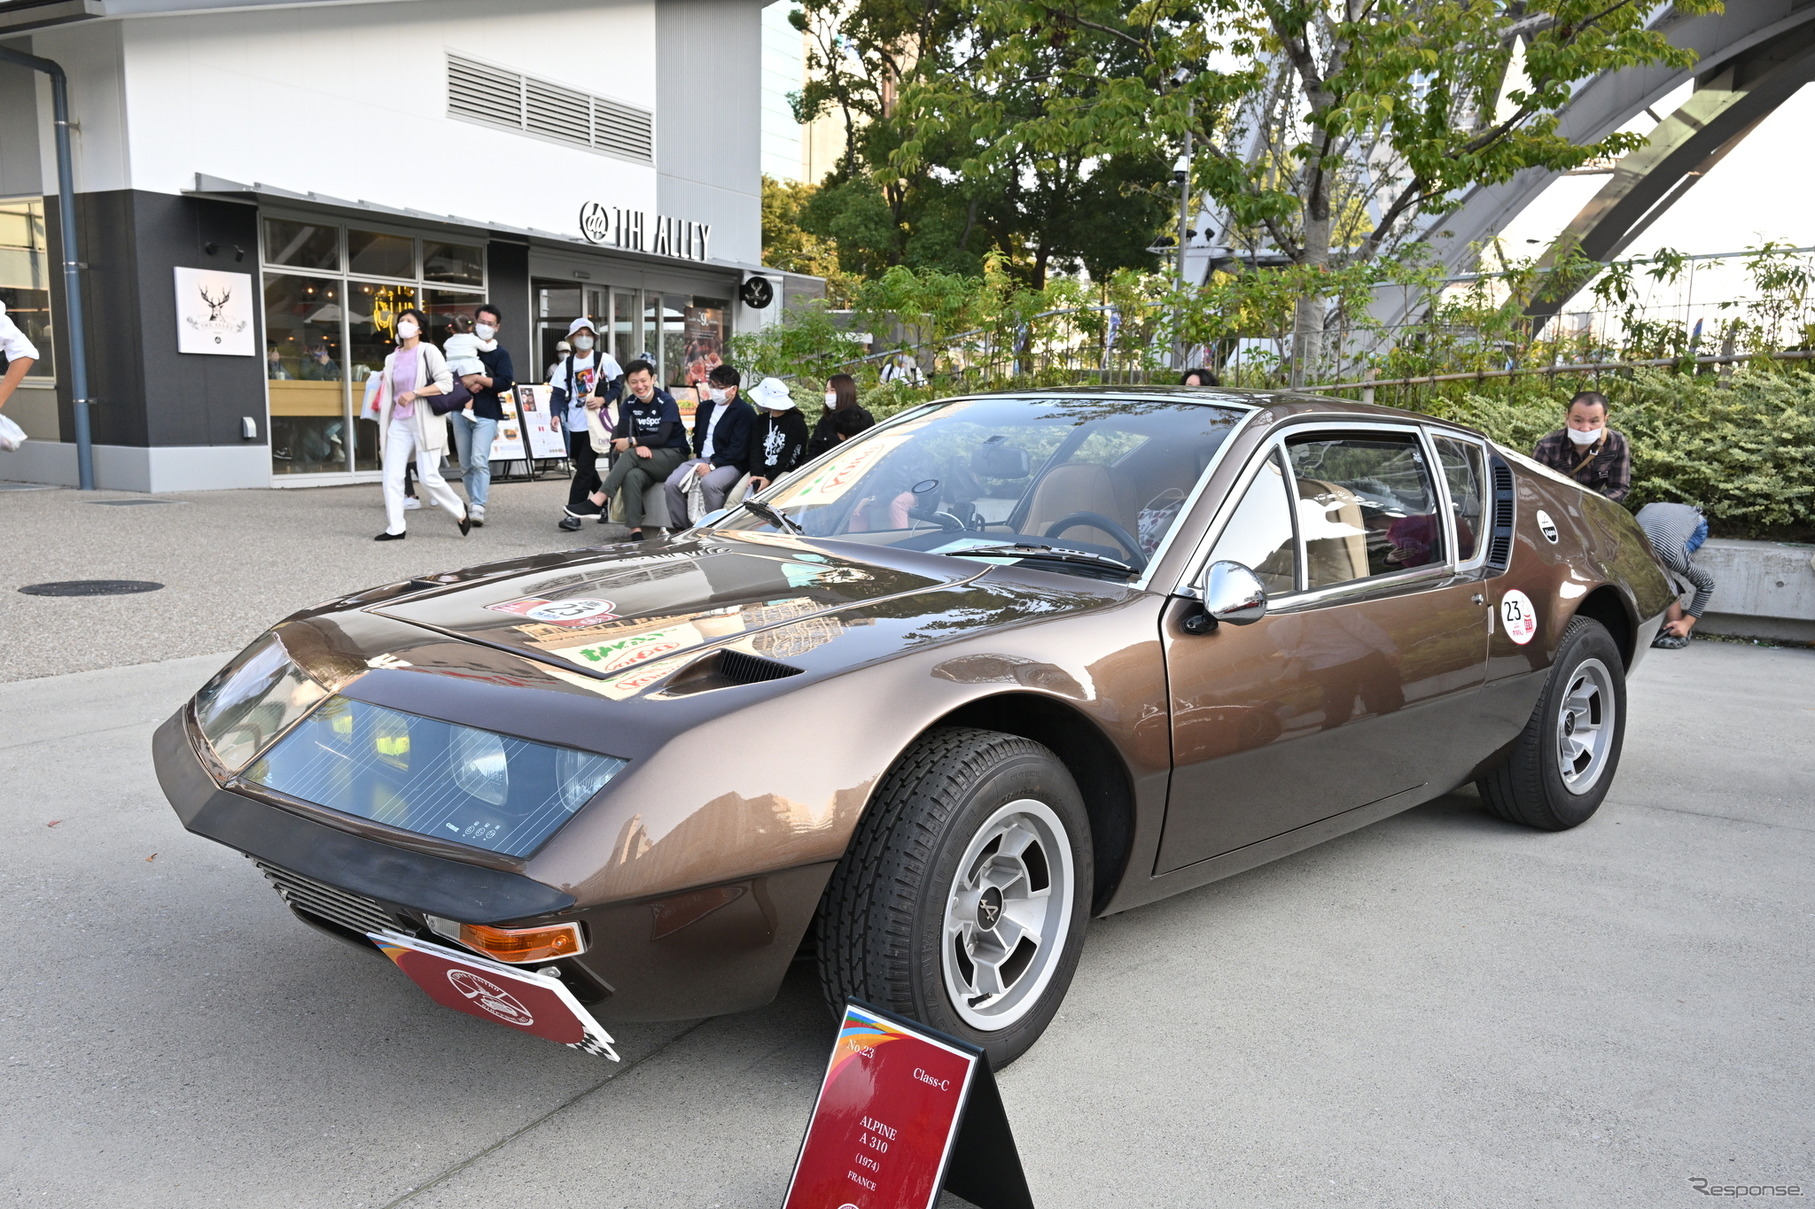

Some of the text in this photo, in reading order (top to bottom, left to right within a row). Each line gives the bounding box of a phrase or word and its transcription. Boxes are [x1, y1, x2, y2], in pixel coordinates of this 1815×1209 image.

[653, 214, 711, 261] ALLEY
[1504, 601, 1521, 621] 23
[847, 1039, 875, 1059] No.23
[913, 1067, 950, 1092] Class-C
[859, 1115, 897, 1141] ALPINE
[859, 1132, 888, 1154] A 310
[855, 1152, 880, 1173] (1974)
[847, 1170, 877, 1192] FRANCE
